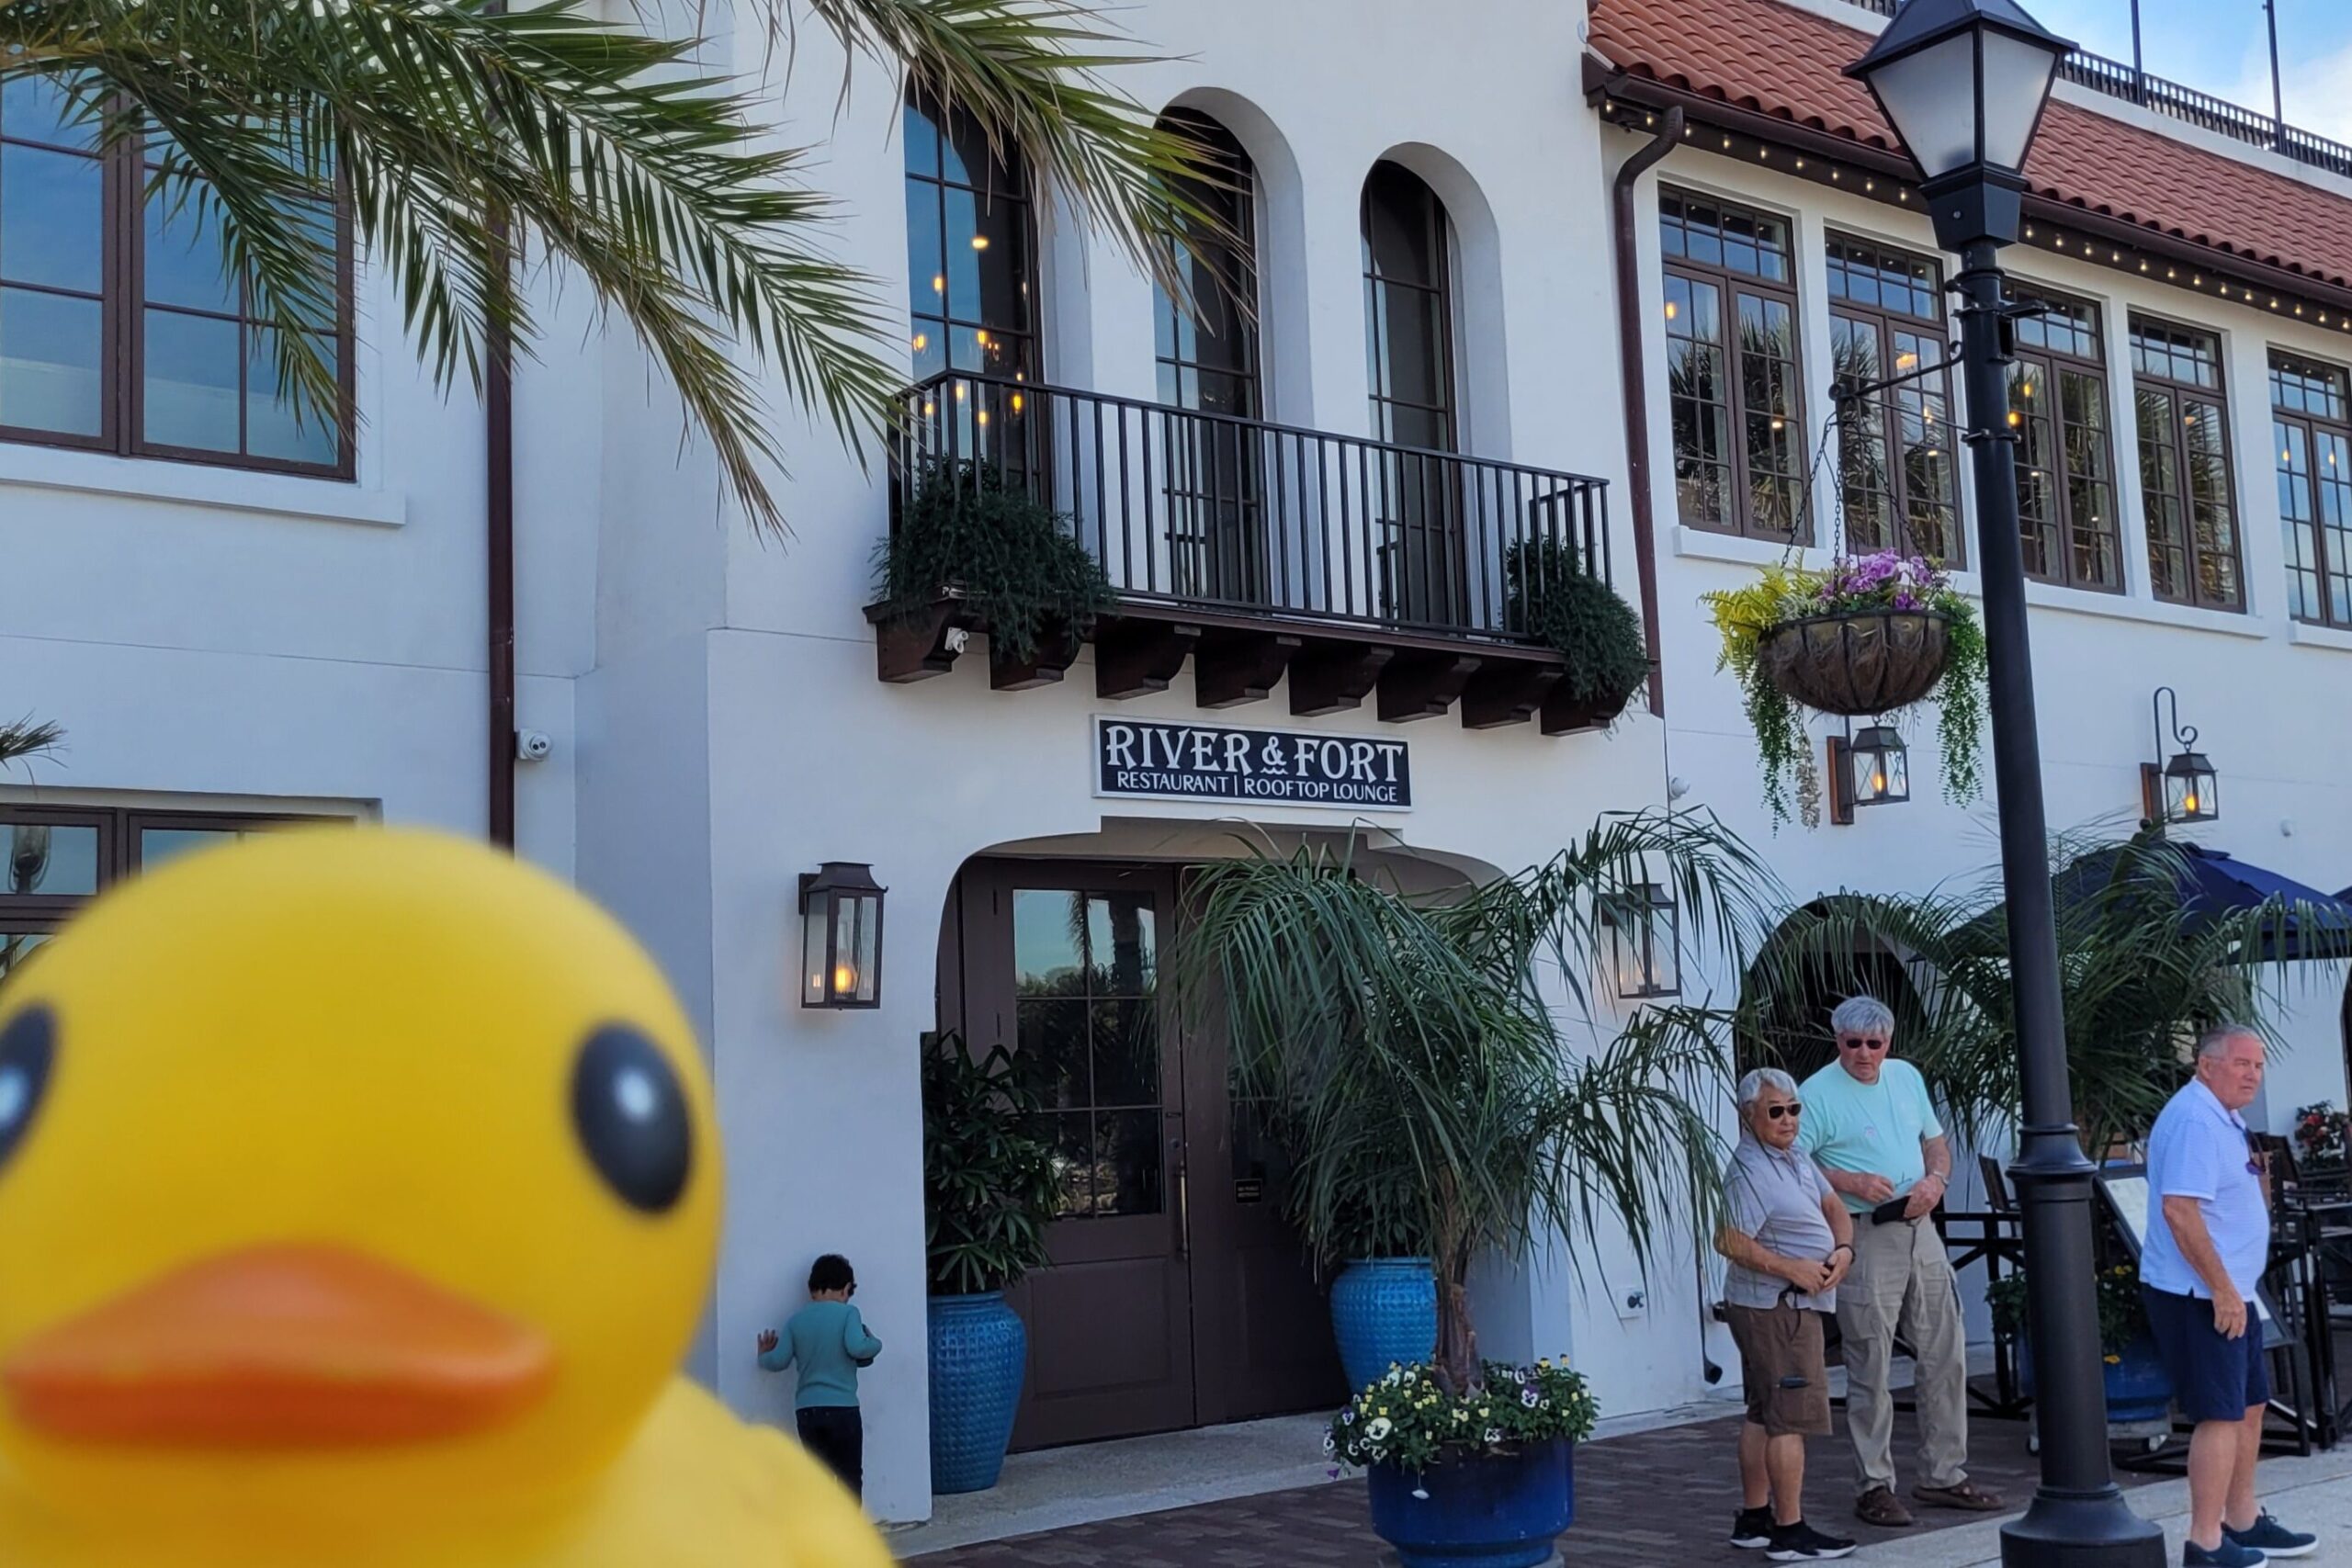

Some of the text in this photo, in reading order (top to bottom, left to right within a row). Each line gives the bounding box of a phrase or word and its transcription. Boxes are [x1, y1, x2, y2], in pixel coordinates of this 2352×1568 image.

[1105, 725, 1404, 784] RIVER & FORT
[1117, 772, 1228, 793] RESTAURANT
[1244, 777, 1329, 799] ROOFTOP
[1333, 783, 1398, 803] LOUNGE
